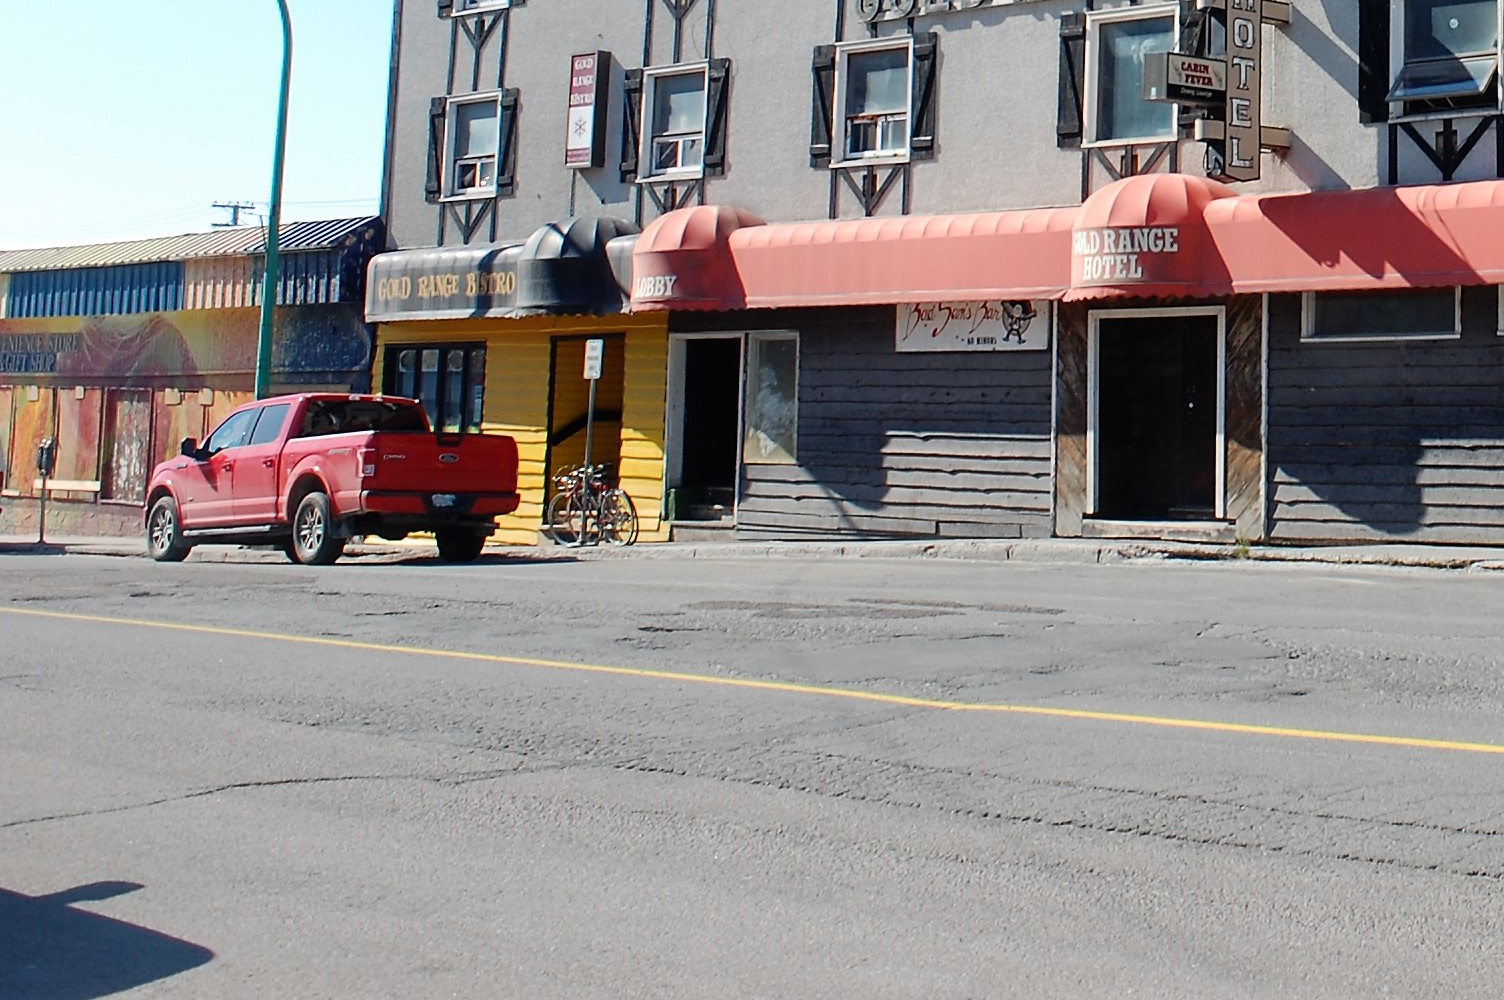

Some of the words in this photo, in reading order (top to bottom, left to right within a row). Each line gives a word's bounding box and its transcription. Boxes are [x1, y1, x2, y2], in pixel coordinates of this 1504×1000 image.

[574, 58, 594, 71] GOLD
[1181, 61, 1210, 75] CABIN
[572, 75, 594, 88] RANGE
[1185, 74, 1214, 87] FEVER
[1102, 227, 1179, 254] RANGE
[1083, 253, 1142, 280] HOTEL
[378, 276, 411, 300] GOLD
[417, 274, 459, 298] RANGE
[465, 271, 516, 297] BISTRO
[635, 275, 677, 298] LOBBY
